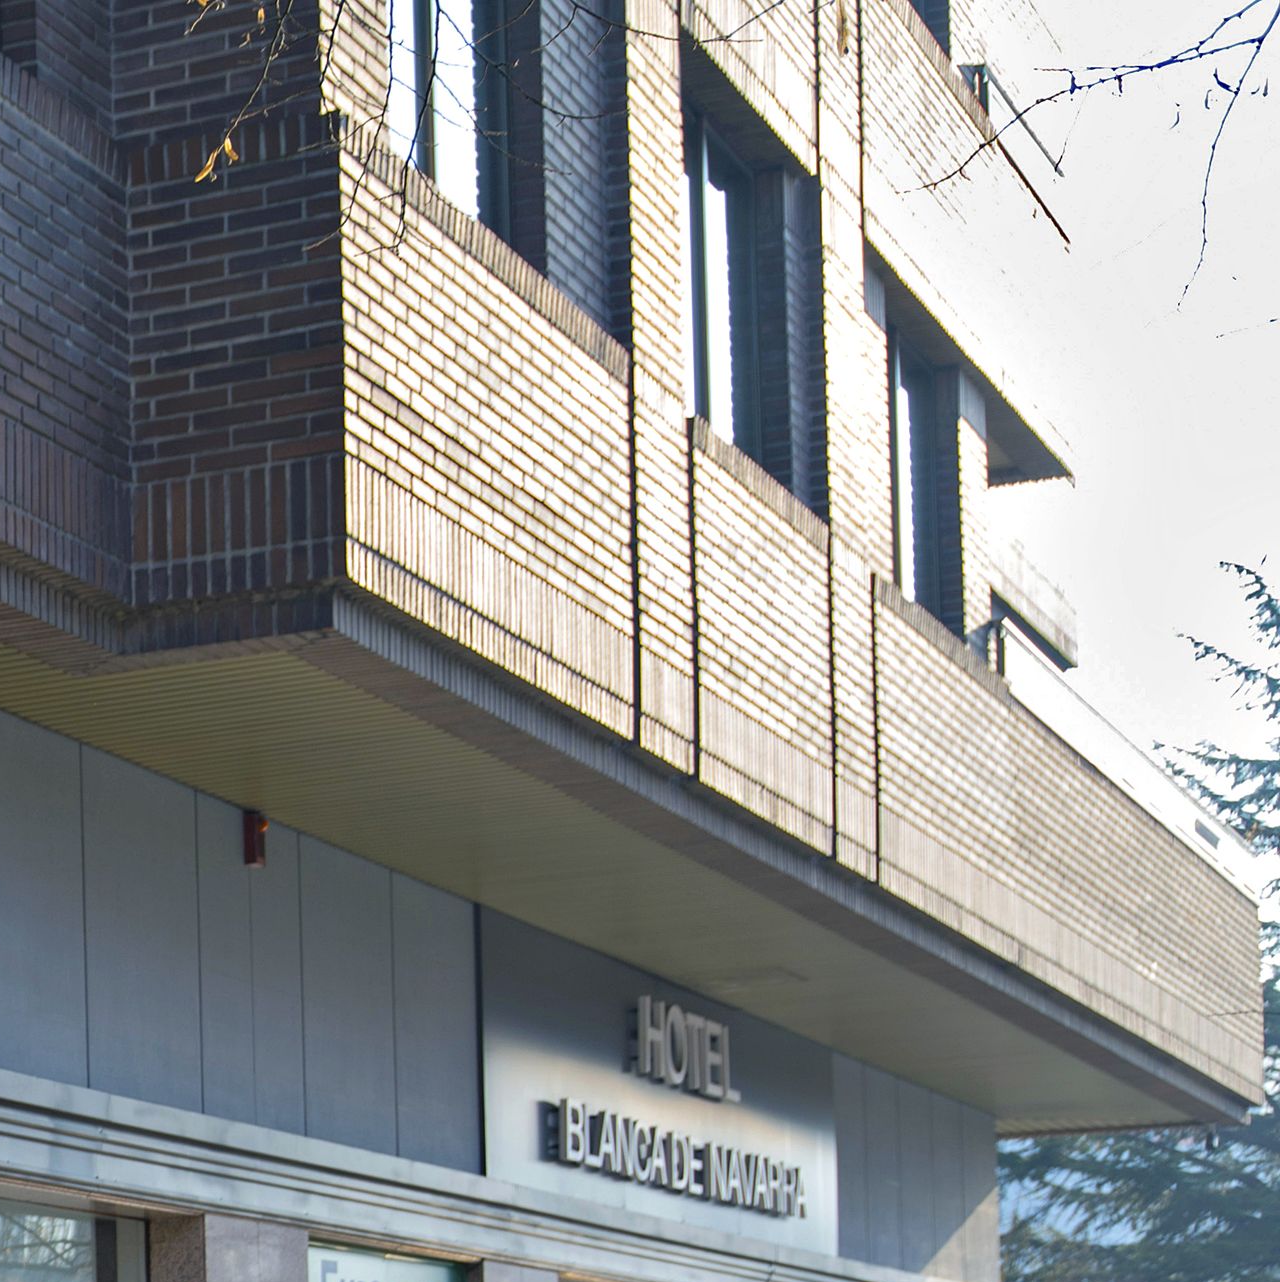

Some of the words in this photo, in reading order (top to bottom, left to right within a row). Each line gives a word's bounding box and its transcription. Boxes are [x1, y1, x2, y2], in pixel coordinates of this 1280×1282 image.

[639, 995, 741, 1102] HOTEL
[560, 1097, 668, 1185] BLANCA
[667, 1131, 704, 1195] DE
[704, 1141, 807, 1218] NAVARRA
